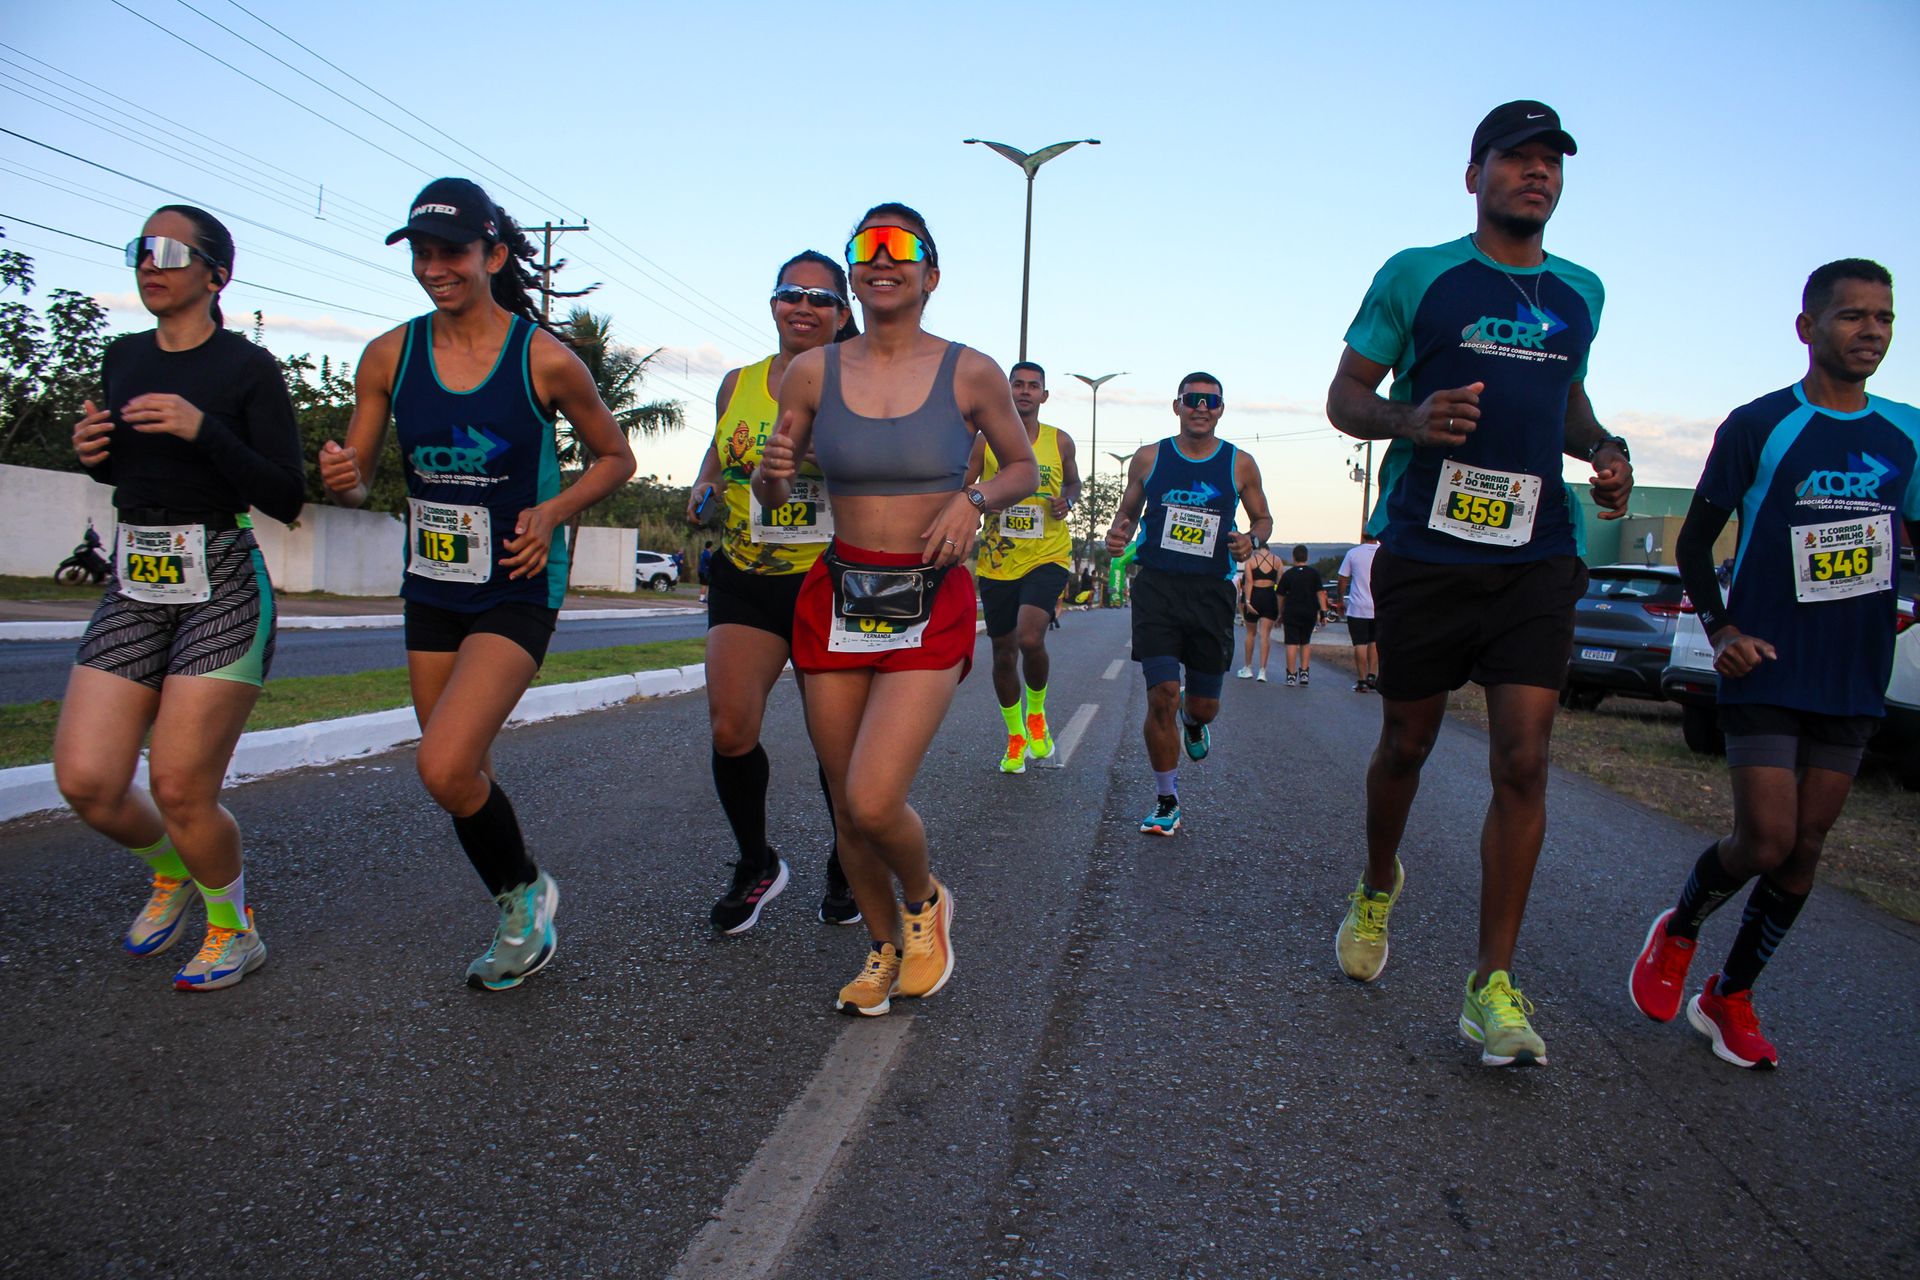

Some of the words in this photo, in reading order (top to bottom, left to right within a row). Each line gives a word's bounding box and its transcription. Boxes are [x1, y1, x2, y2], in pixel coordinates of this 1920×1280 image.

[1459, 342, 1497, 351] ASSOCIAÇÃO
[1511, 348, 1547, 358] CORREDORES
[1465, 478, 1478, 487] DO
[1480, 480, 1509, 492] MILHO
[1475, 472, 1510, 484] CORRIDA
[1795, 470, 1879, 499] ACORR
[1795, 498, 1833, 506] ASSOCIAÇÃO
[427, 507, 458, 517] CORRIDA
[772, 502, 808, 526] 182
[1453, 493, 1507, 527] 359
[432, 515, 458, 525] MILHO
[1008, 516, 1031, 529] 303
[1172, 524, 1203, 544] 422
[1828, 524, 1863, 535] CORRIDA
[1821, 535, 1834, 544] DO
[1836, 531, 1864, 542] MILHO
[424, 530, 455, 562] 113
[130, 554, 179, 583] 234
[1814, 547, 1868, 580] 346
